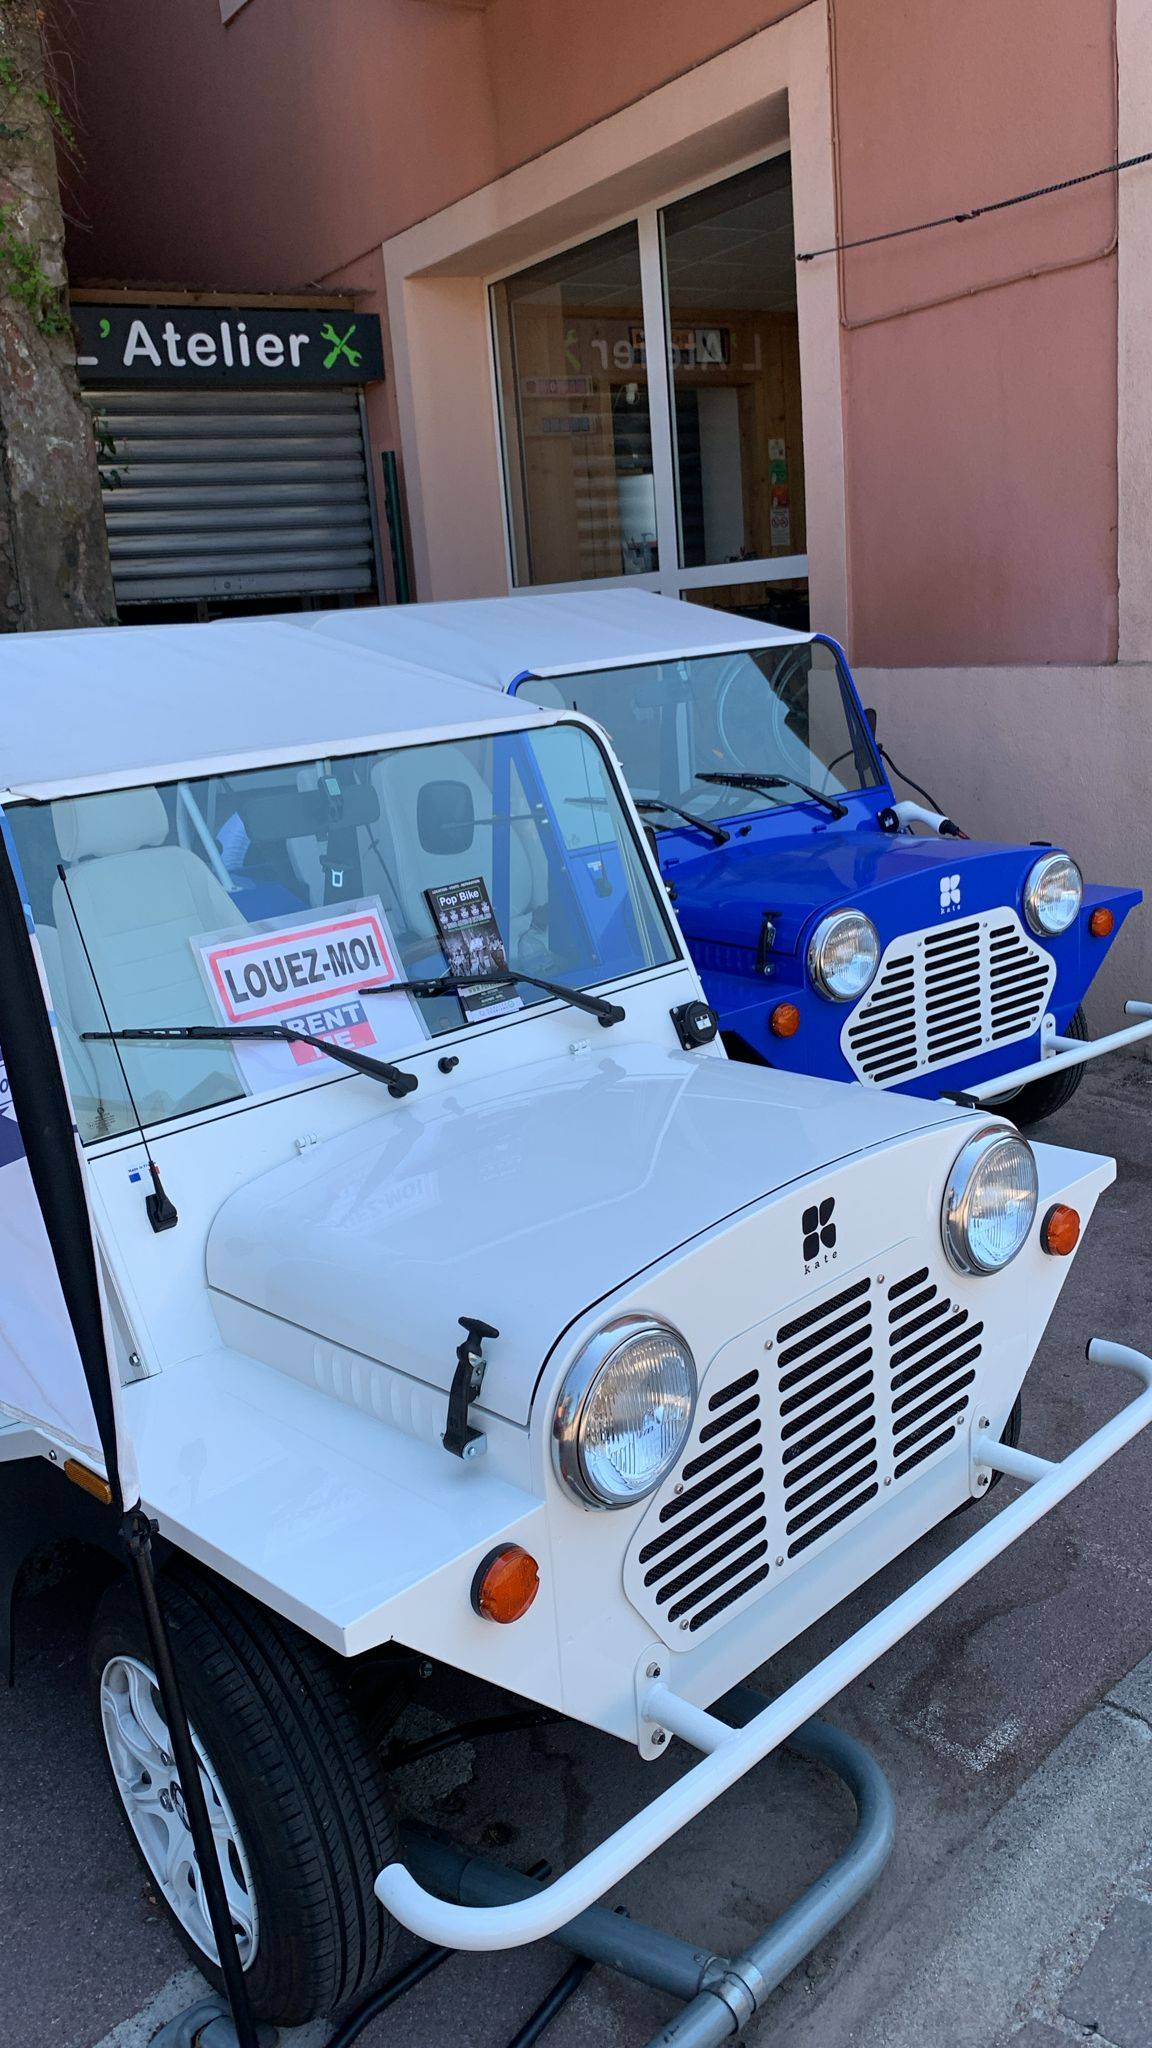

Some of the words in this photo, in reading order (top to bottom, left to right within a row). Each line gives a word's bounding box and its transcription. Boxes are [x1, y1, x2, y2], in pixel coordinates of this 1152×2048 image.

[224, 934, 381, 1004] LOUEZ-MOI
[286, 1003, 360, 1036] RENT
[804, 1251, 838, 1275] kate
